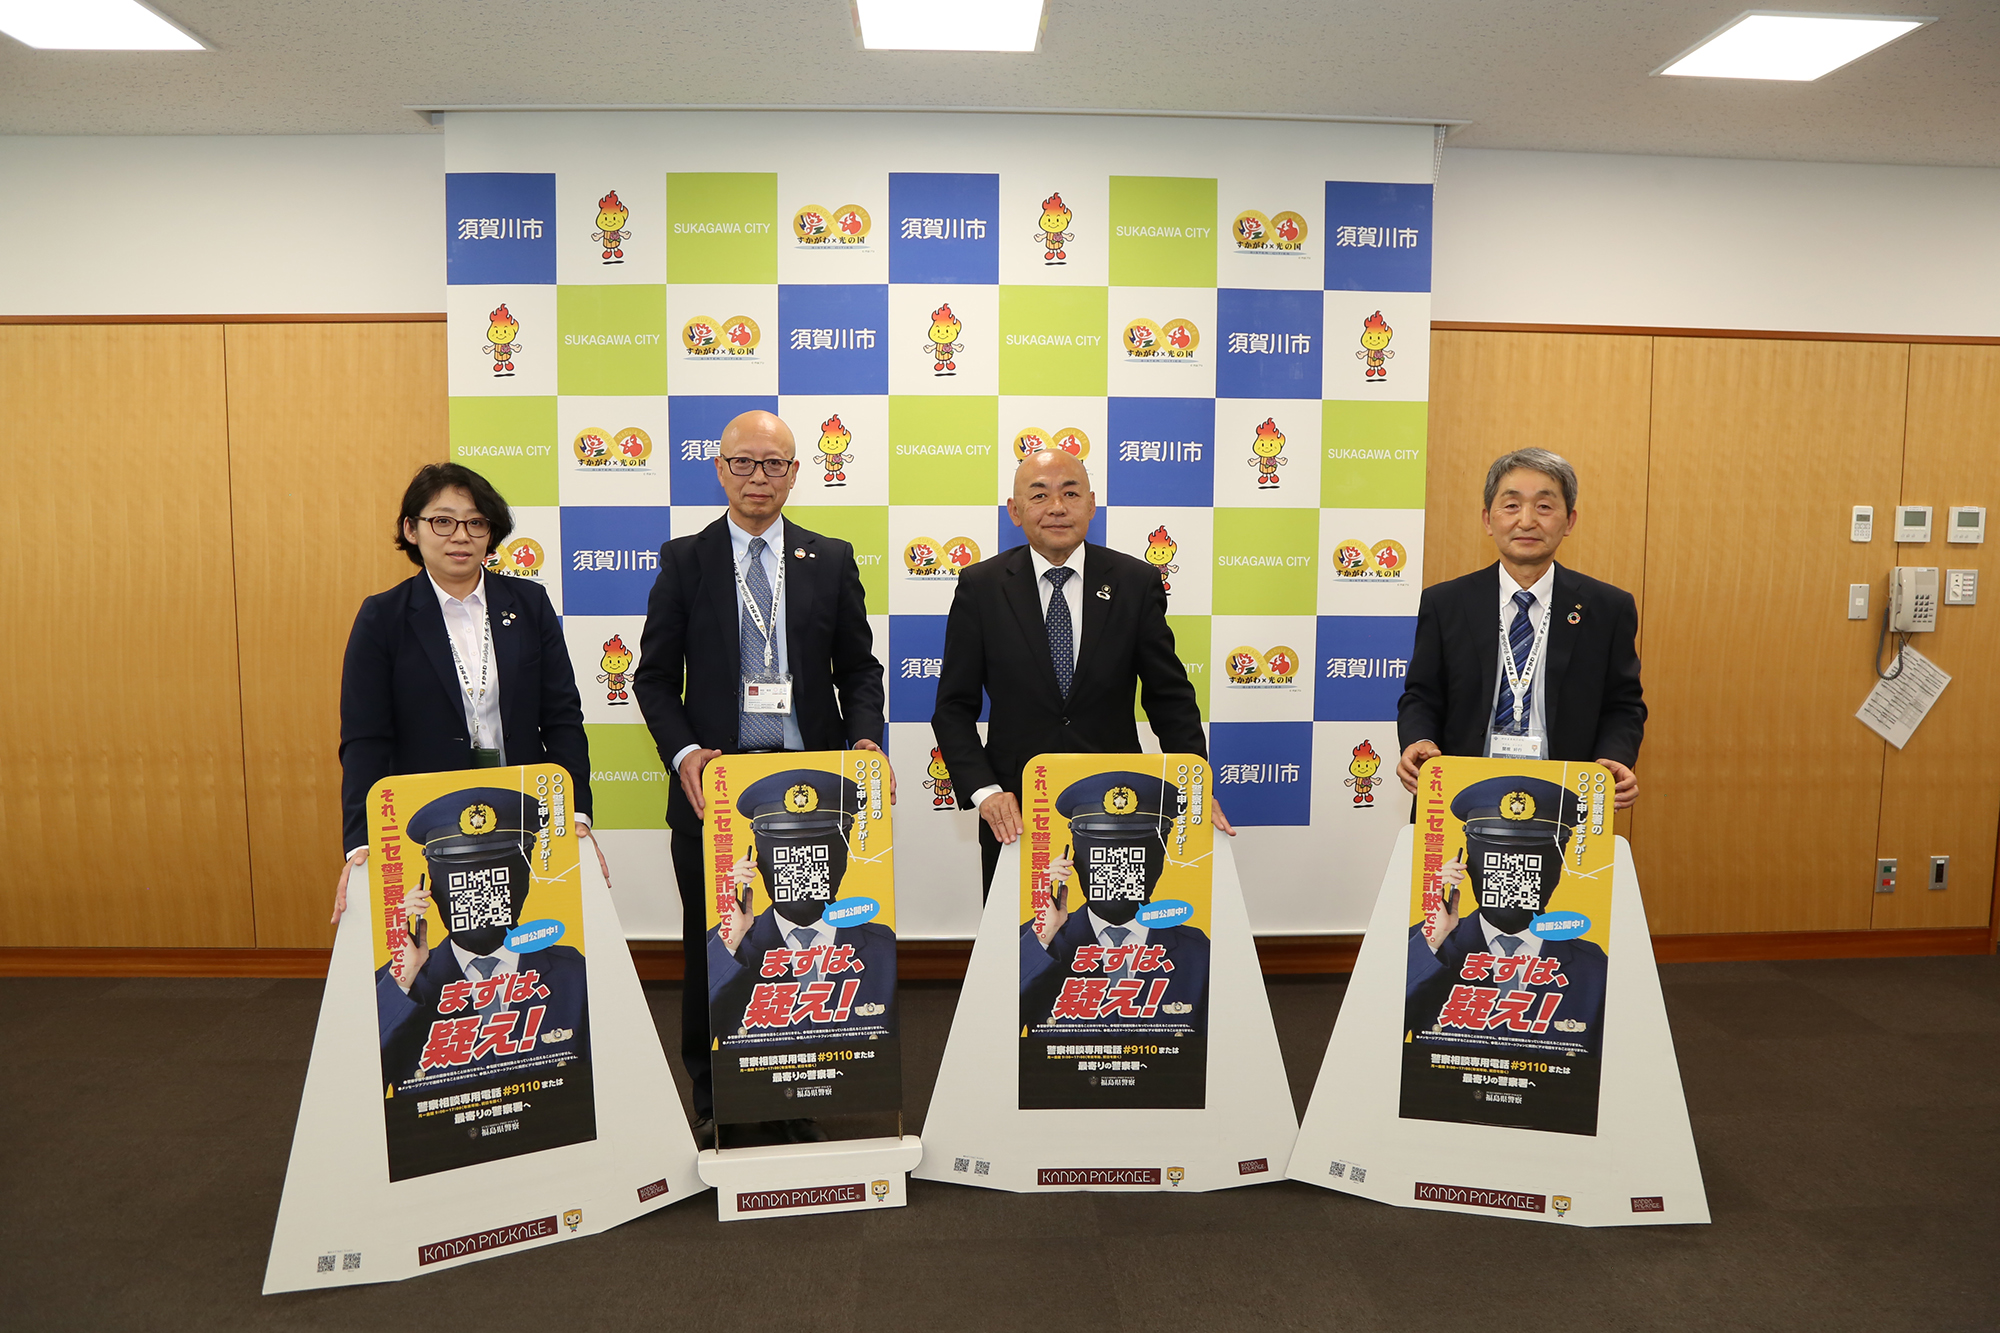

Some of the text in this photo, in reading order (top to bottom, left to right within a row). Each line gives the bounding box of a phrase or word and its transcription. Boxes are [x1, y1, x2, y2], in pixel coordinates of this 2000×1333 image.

[458, 218, 544, 240] 須賀川市
[674, 222, 770, 234] SUKAGAWA CITY
[900, 218, 986, 240] 須賀川市
[1116, 226, 1210, 238] SUKAGAWA CITY
[1336, 226, 1418, 248] 須賀川市
[564, 334, 660, 346] SUKAGAWA CITY
[790, 328, 876, 350] 須賀川市
[1006, 334, 1102, 346] SUKAGAWA CITY
[1228, 332, 1312, 354] 須賀川市
[458, 446, 552, 456] SUKAGAWA CITY
[680, 440, 721, 460] 須賀
[896, 444, 992, 456] SUKAGAWA CITY
[1120, 440, 1202, 462] 須賀川市
[1328, 448, 1420, 460] SUKAGAWA CITY
[572, 550, 658, 570] 須賀川市
[856, 554, 882, 566] CITY
[1218, 556, 1310, 566] SUKAGAWA CITY
[901, 658, 942, 678] 須賀
[1326, 658, 1408, 678] 須賀川市
[590, 771, 666, 782] KAGAWA CITY
[1220, 762, 1300, 784] 須賀川市
[760, 944, 865, 978] まずは、
[1071, 944, 1174, 972] まずは、
[1460, 952, 1569, 988] まずは、
[437, 969, 551, 1014] まずは、
[818, 1050, 852, 1062] #9110
[1123, 1045, 1158, 1054] #9110
[1078, 1061, 1148, 1071] 最寄りの警察署へ
[1510, 1060, 1548, 1073] #9110
[772, 1068, 844, 1083] 最寄りの警察署へ
[1462, 1073, 1536, 1088] 最寄りの警察署へ
[502, 1080, 540, 1096] #9110
[454, 1101, 532, 1124] 最寄りの警察署へ
[1042, 1171, 1087, 1184] KANDA
[742, 1192, 788, 1209] KANDA
[1420, 1185, 1467, 1202] KANDA
[424, 1238, 476, 1262] KANDA
